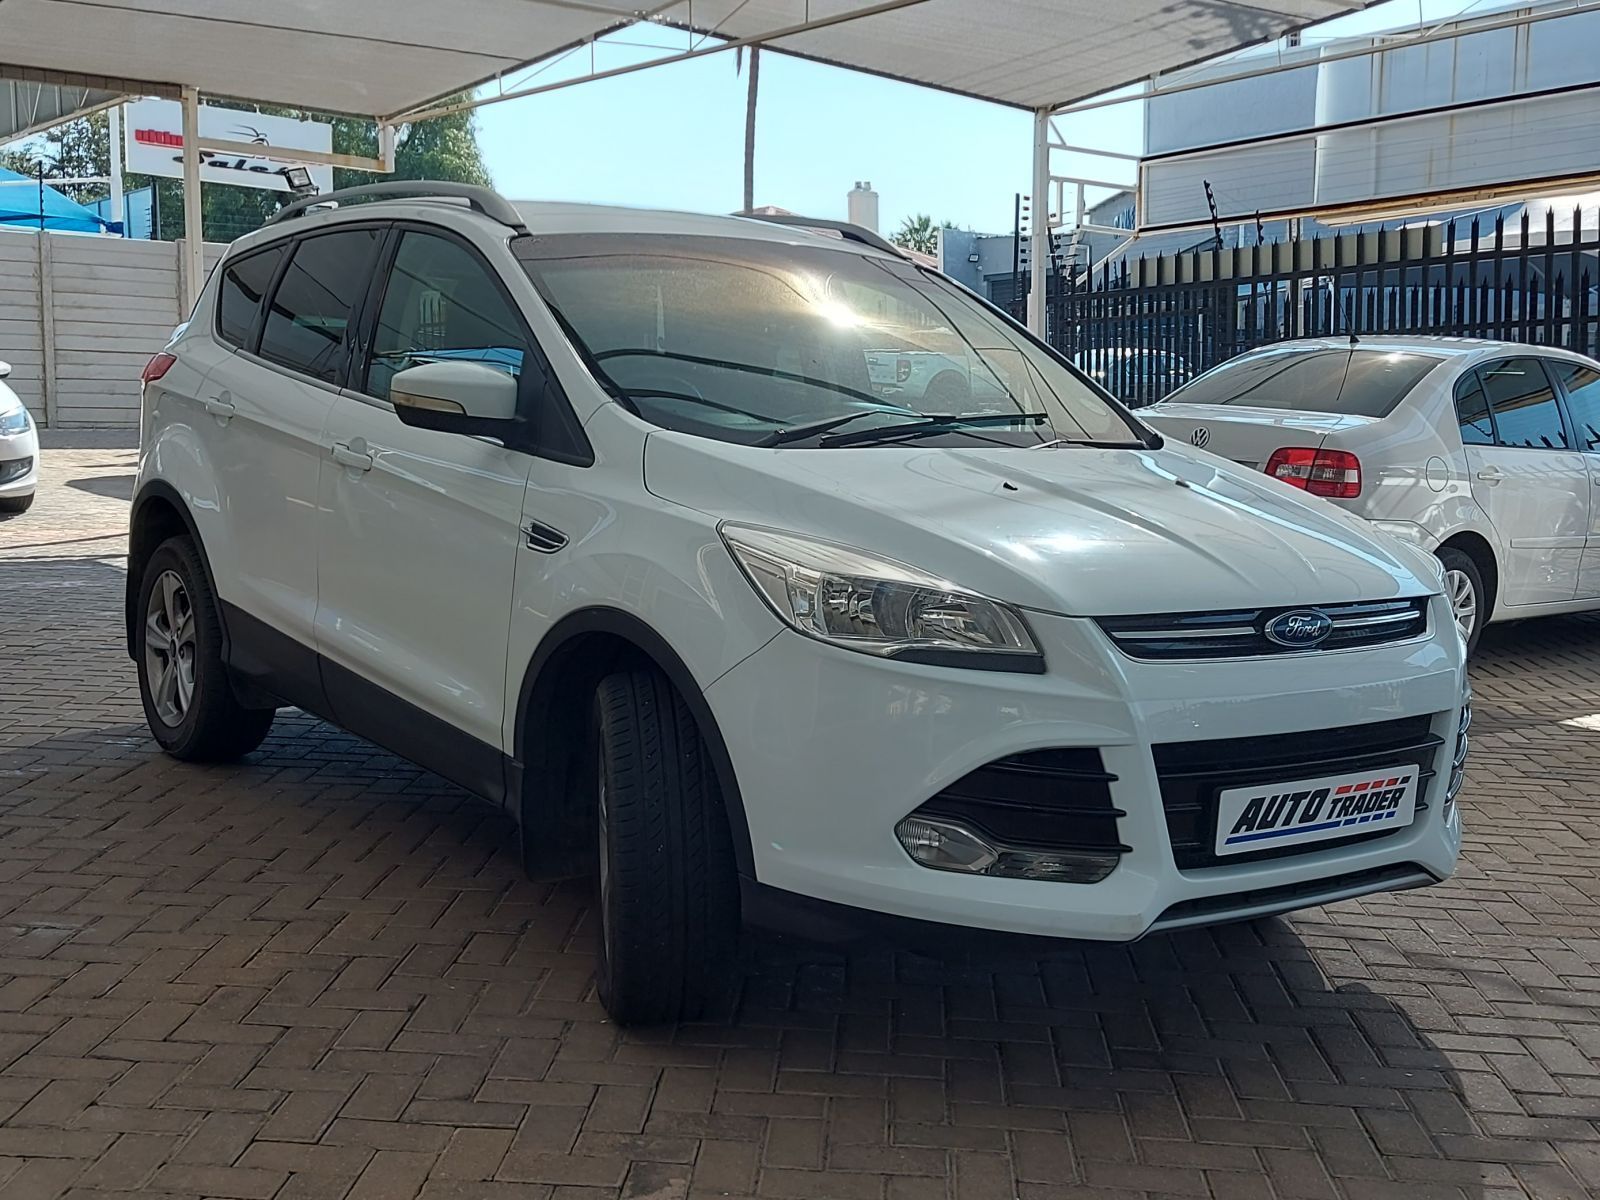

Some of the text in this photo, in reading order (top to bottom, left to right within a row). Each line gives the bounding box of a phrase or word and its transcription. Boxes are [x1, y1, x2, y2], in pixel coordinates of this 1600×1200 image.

[1286, 616, 1320, 637] Ford
[1230, 787, 1406, 834] AUTO TRADER
